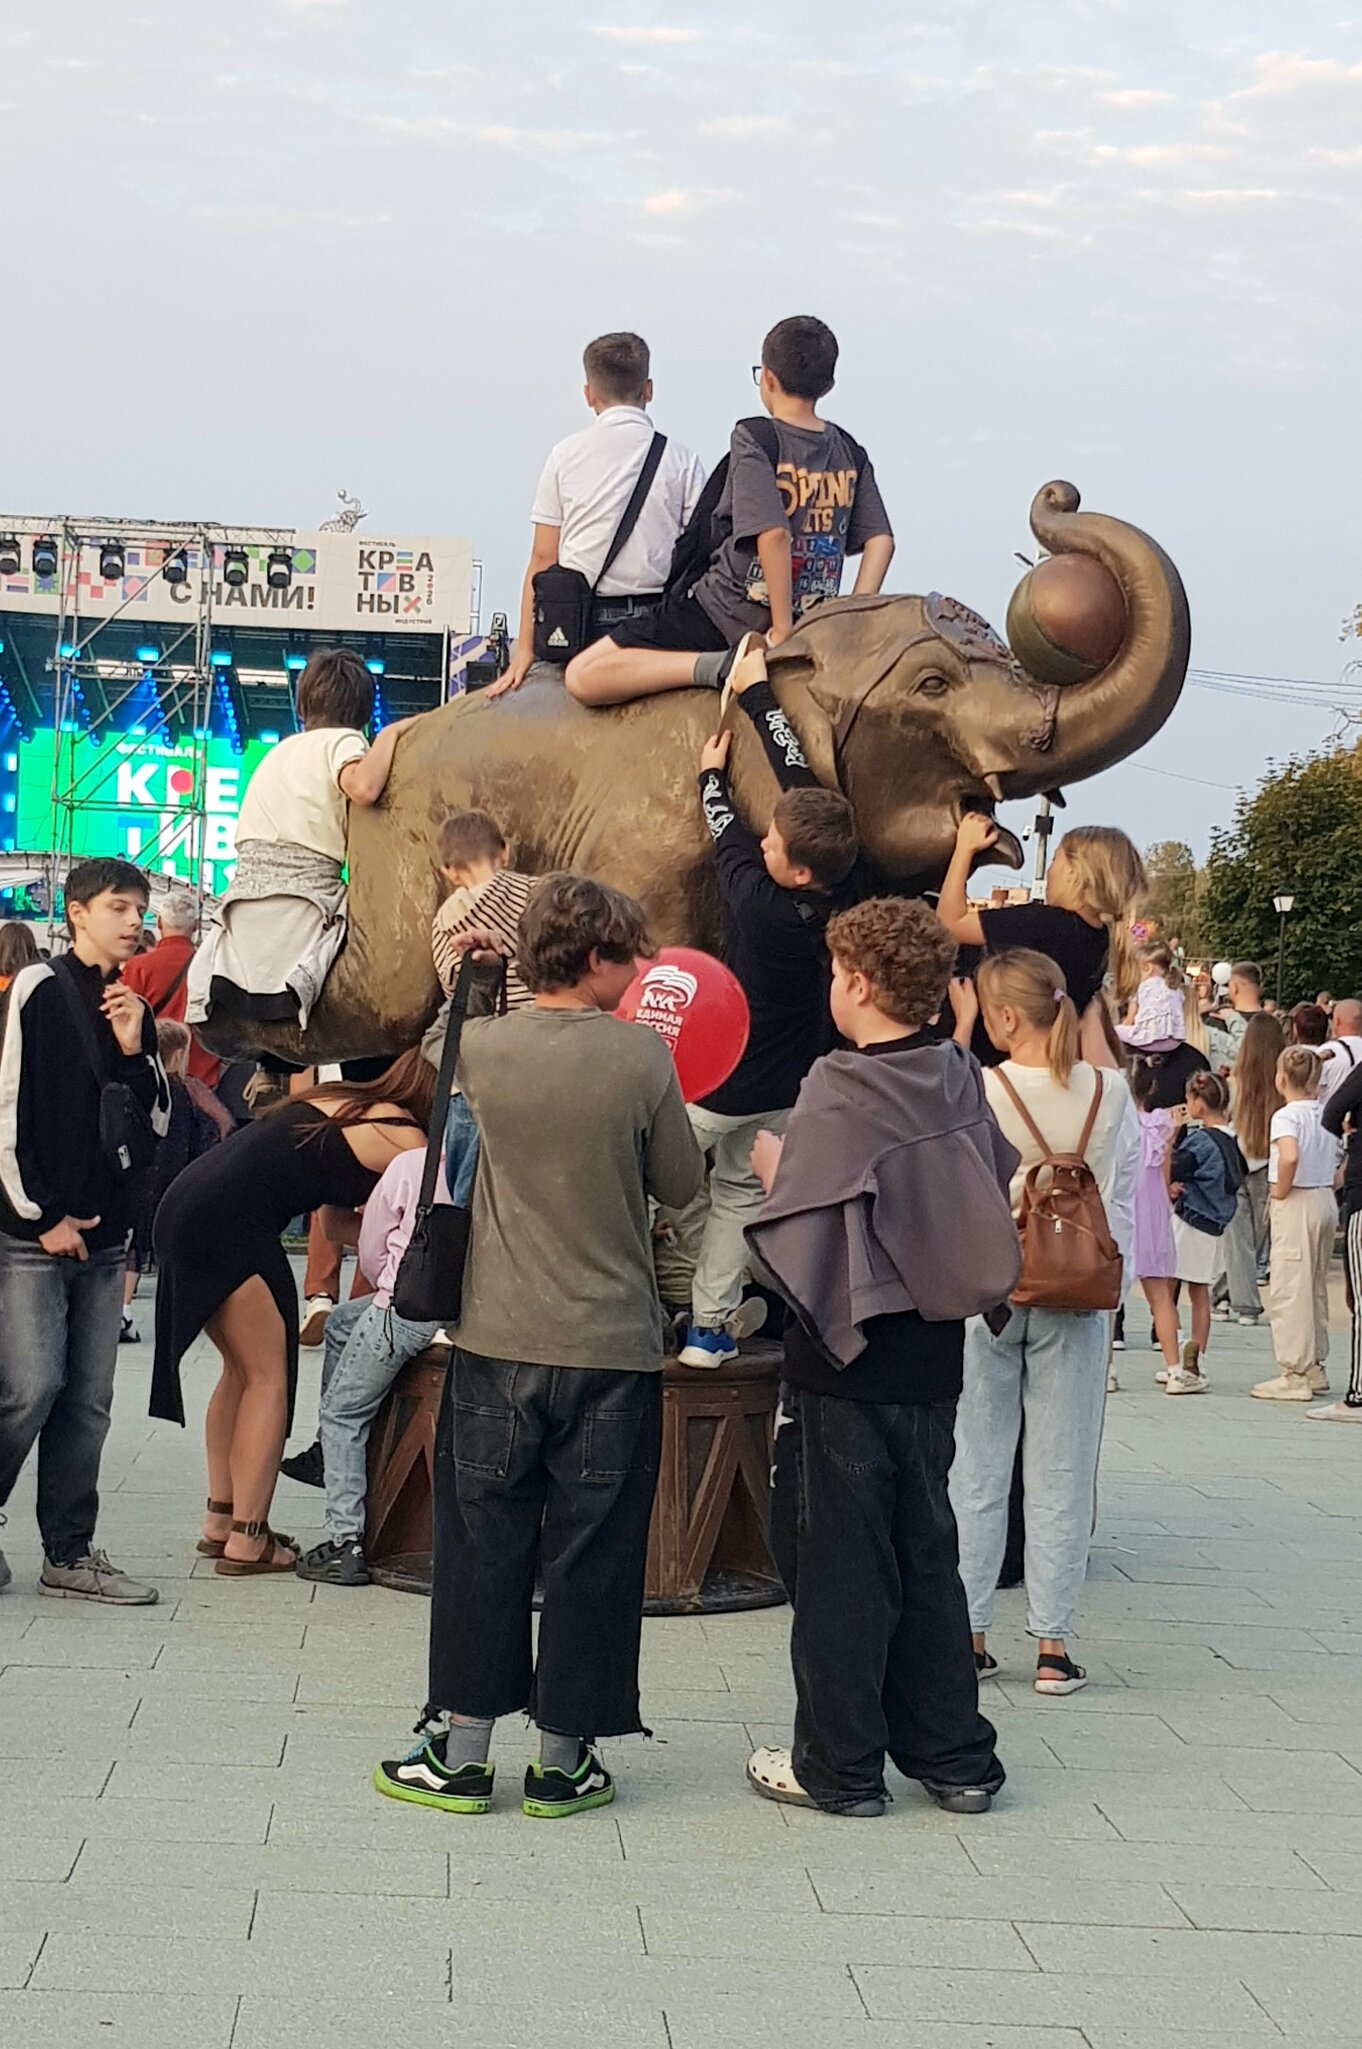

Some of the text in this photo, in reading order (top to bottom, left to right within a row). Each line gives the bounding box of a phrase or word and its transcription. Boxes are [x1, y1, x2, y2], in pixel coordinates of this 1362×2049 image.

[170, 582, 315, 610] С НАМИ!
[636, 1009, 683, 1027] ЕДИНАЯ
[635, 1019, 680, 1037] ССИЯ
